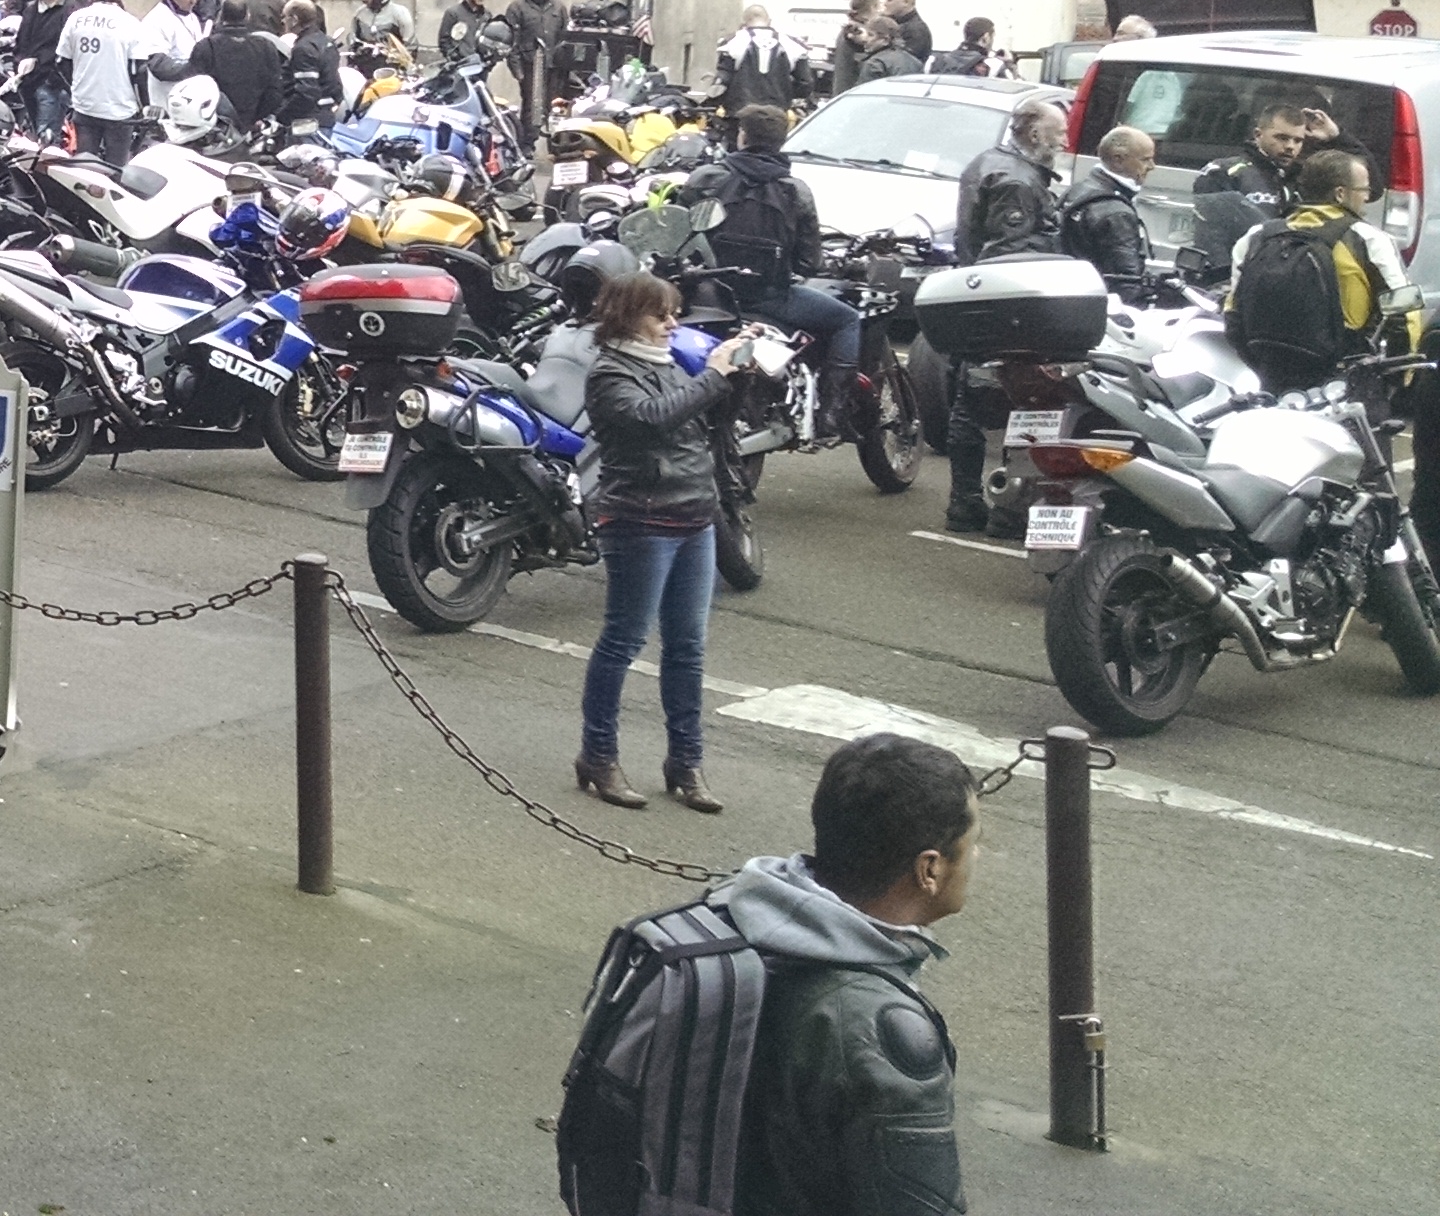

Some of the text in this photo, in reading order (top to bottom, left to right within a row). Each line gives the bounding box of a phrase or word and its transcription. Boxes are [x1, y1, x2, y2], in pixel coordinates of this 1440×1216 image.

[74, 16, 116, 30] FFMC
[1373, 24, 1415, 37] STOP
[80, 36, 100, 54] 89
[208, 349, 286, 397] SUZUKI
[1037, 509, 1074, 518] NON AU
[1028, 519, 1078, 530] CONTRÔLE
